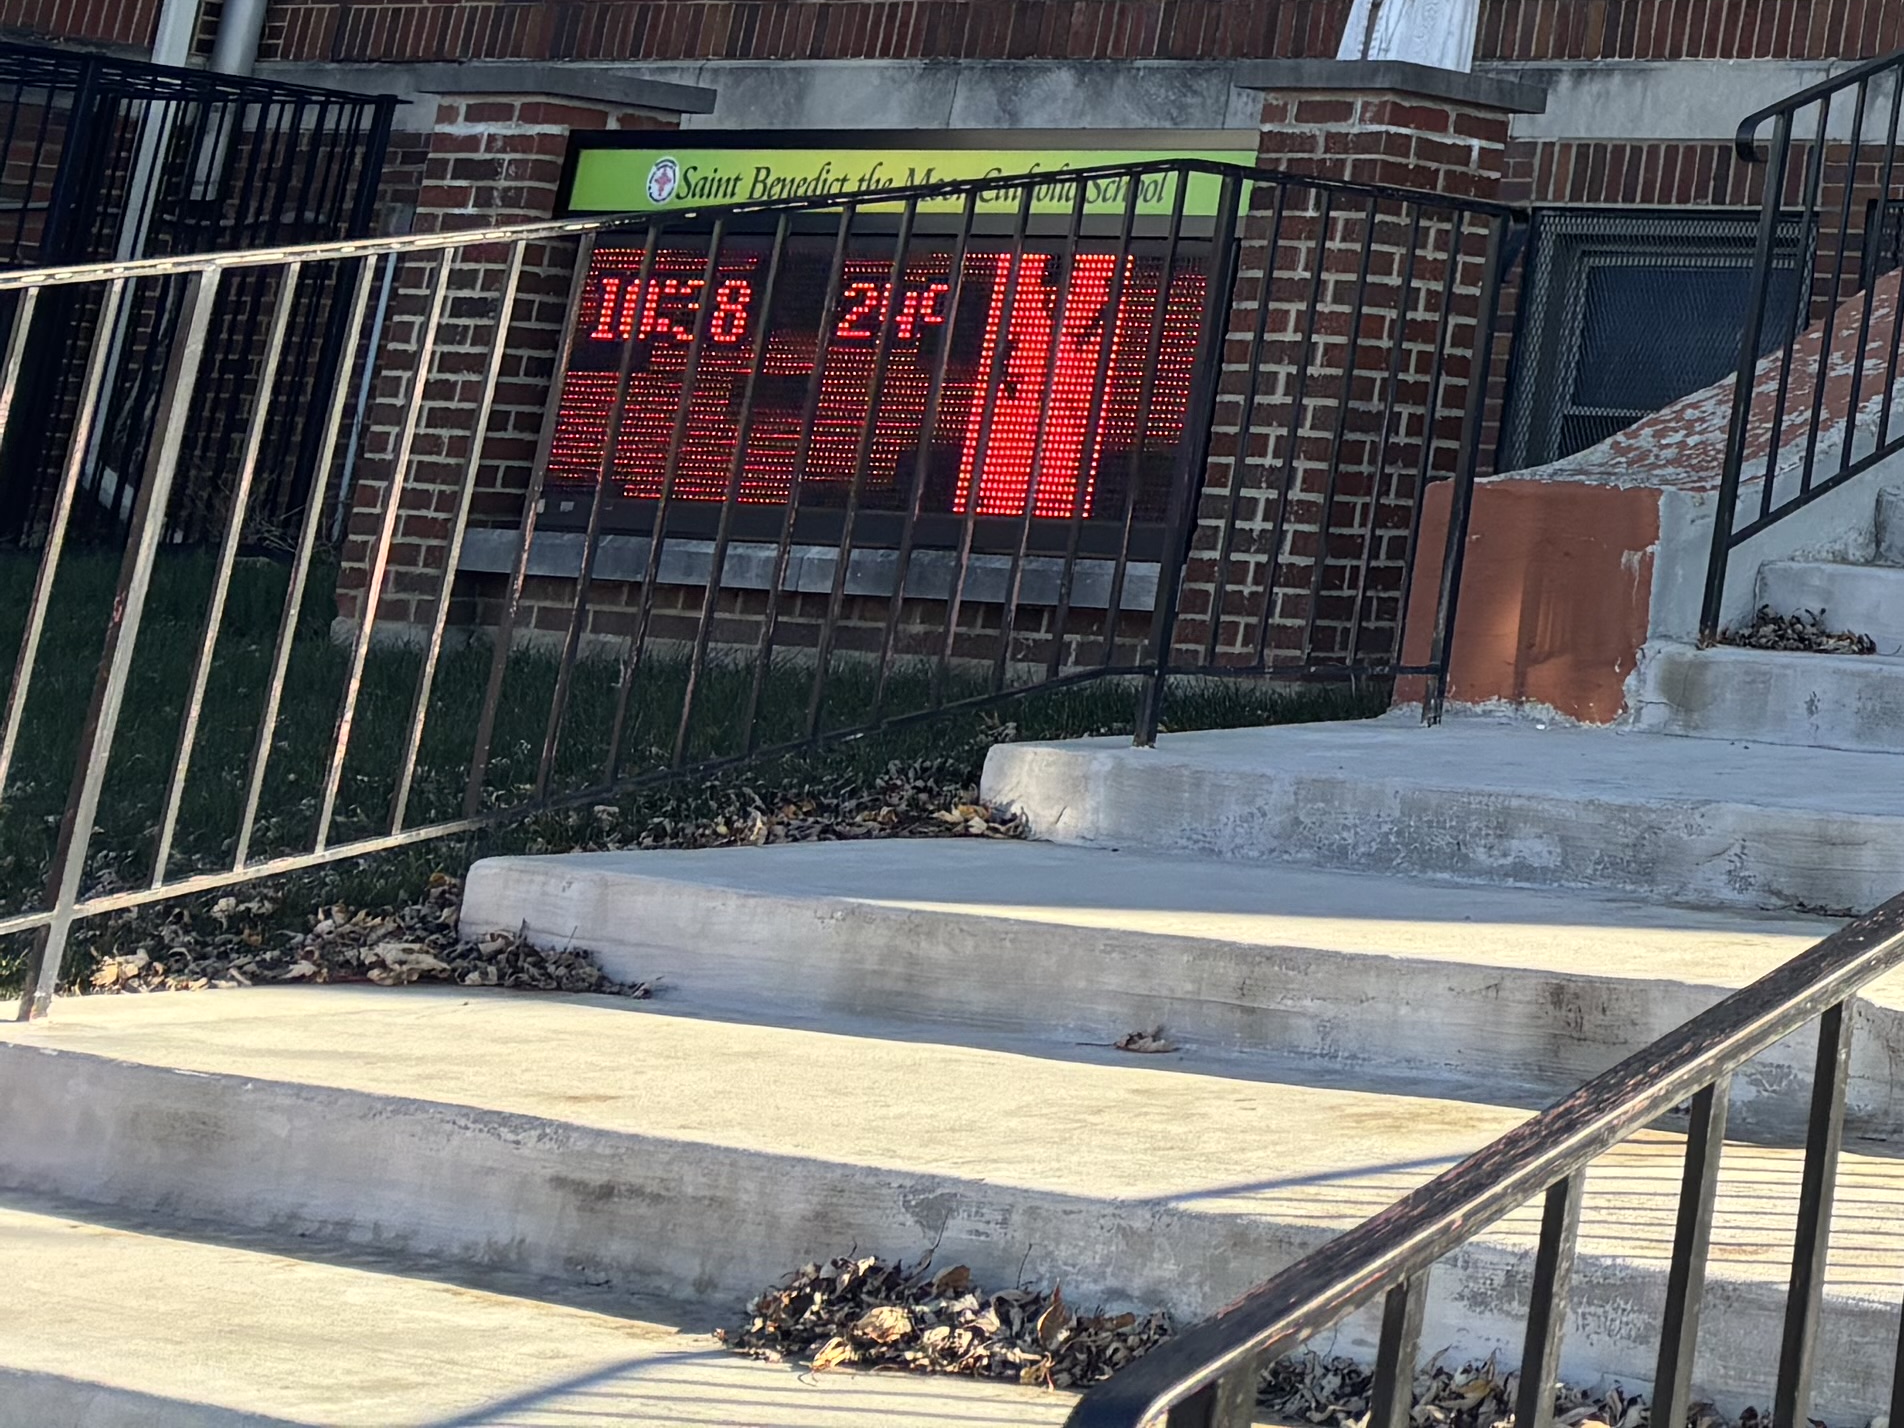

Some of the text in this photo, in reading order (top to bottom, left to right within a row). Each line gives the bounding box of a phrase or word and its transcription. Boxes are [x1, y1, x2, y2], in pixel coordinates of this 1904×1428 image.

[676, 166, 742, 200] Saint
[747, 161, 850, 200] Benedict
[979, 162, 1077, 203] Colic
[1086, 171, 1166, 204] Schol
